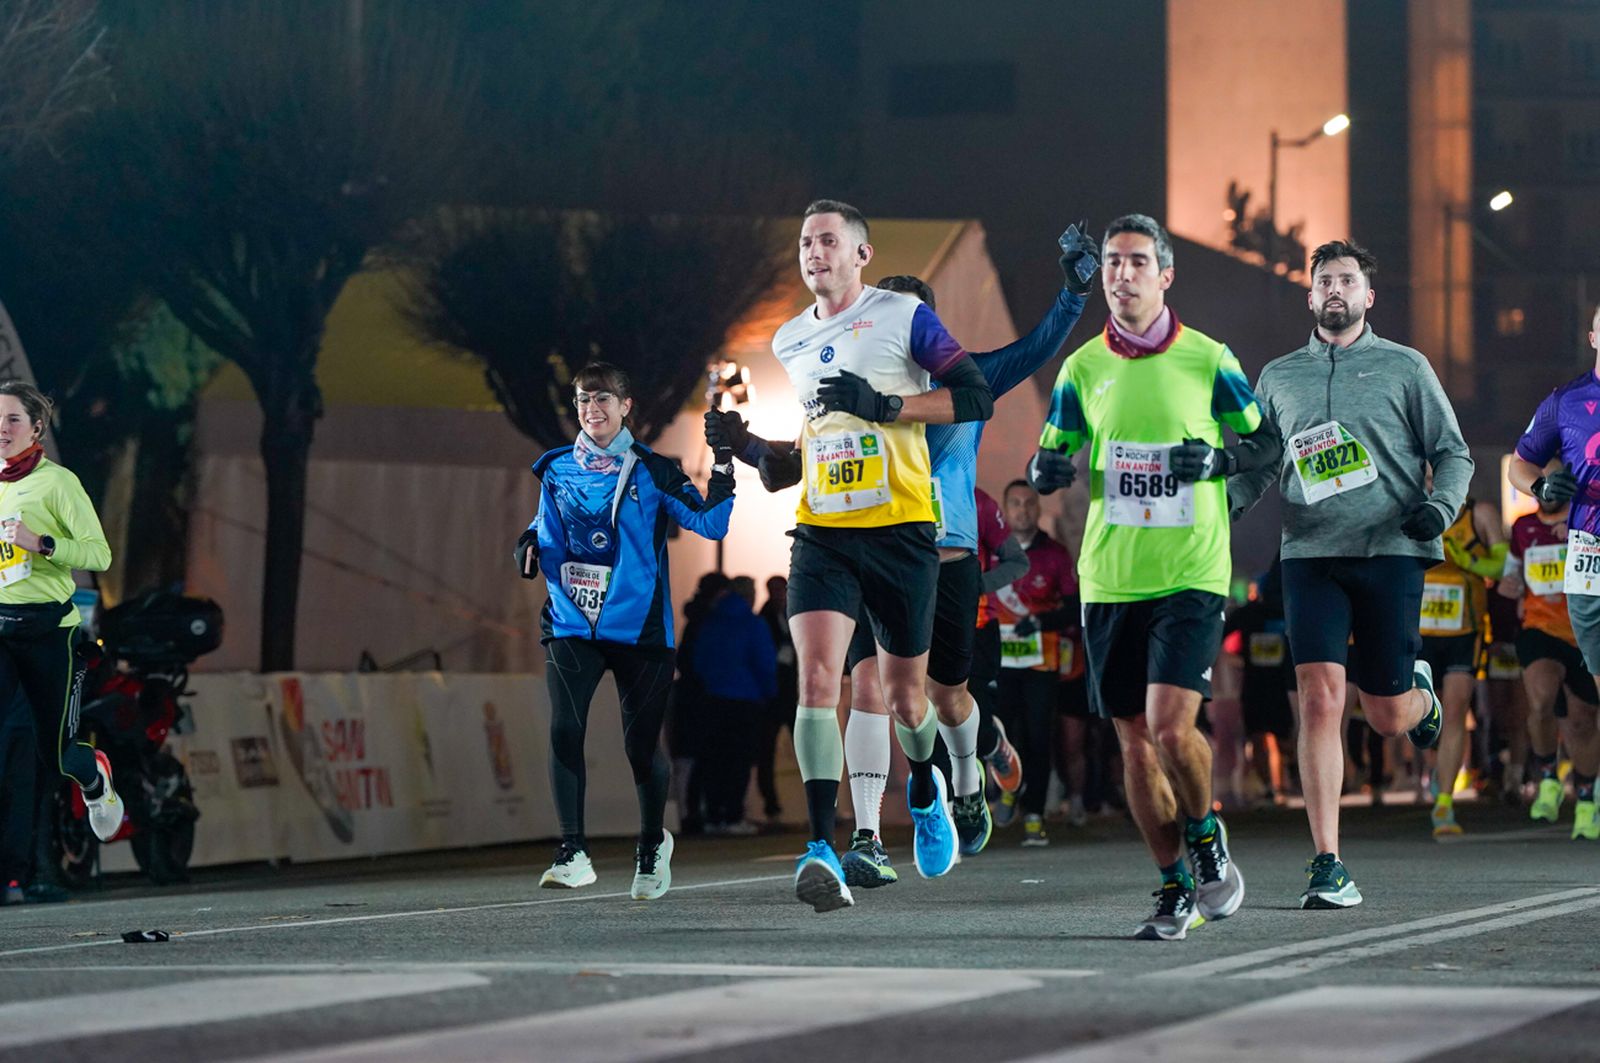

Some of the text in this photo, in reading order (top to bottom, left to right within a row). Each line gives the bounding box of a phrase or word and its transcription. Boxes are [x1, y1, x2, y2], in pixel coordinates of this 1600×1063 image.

[1125, 452, 1149, 461] NOCHE
[1151, 451, 1162, 462] DE
[1299, 446, 1314, 458] SAN
[1304, 441, 1359, 477] 13827
[828, 459, 864, 485] 967
[1115, 460, 1131, 470] SAN
[1119, 472, 1178, 497] 6589
[1541, 563, 1559, 577] 771
